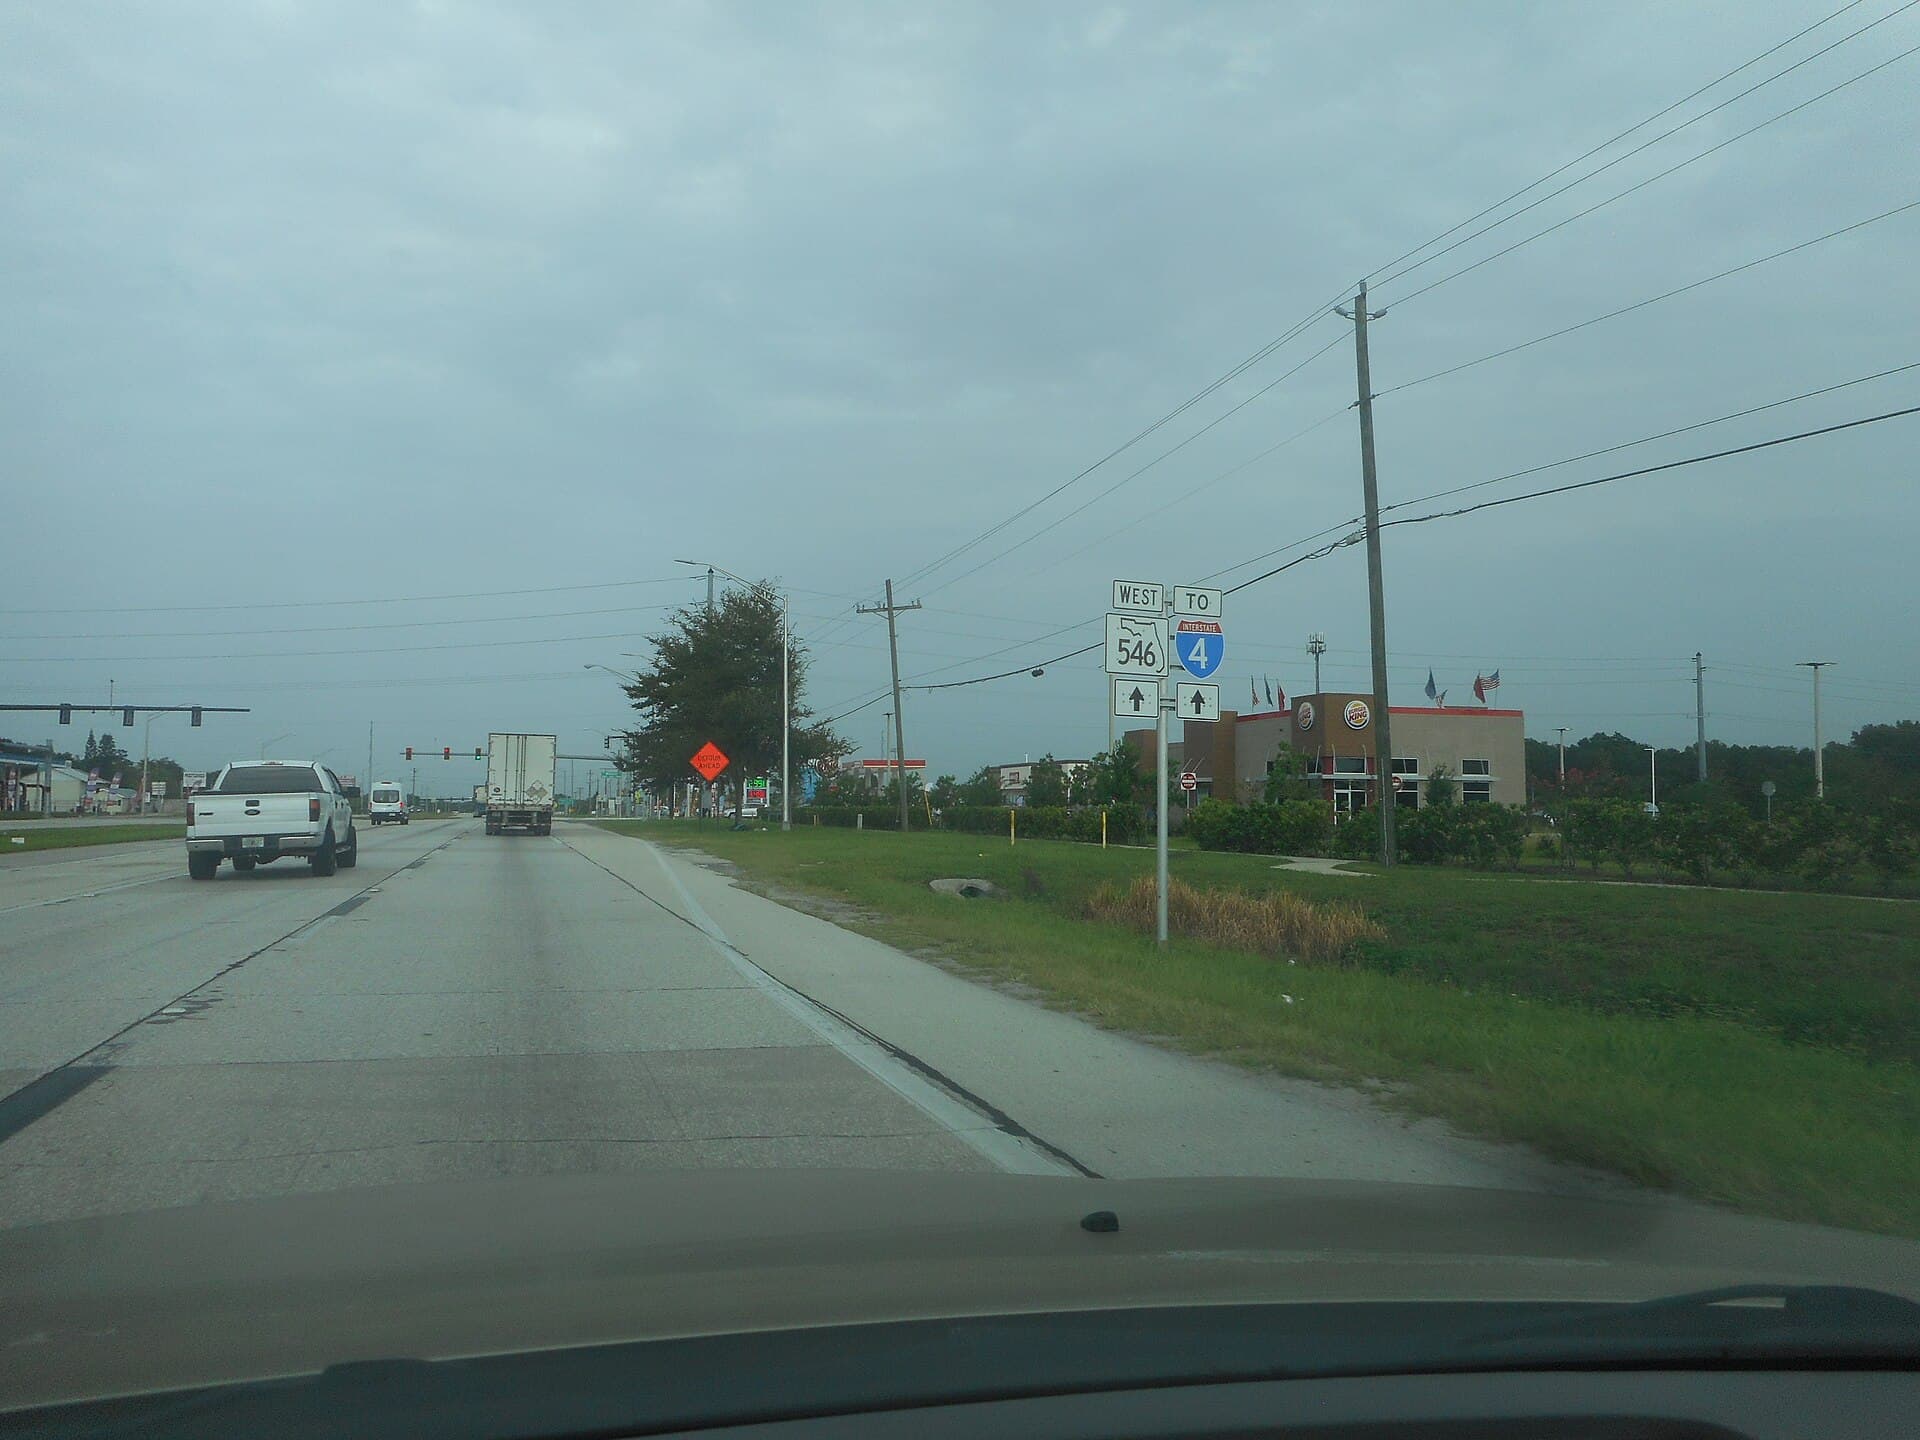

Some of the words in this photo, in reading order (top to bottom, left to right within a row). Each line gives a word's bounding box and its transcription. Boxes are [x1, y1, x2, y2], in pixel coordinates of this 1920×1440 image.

[1120, 585, 1157, 606] WEST
[1185, 592, 1209, 611] TO
[1182, 623, 1217, 632] INTERSTATE
[1118, 638, 1156, 667] 546
[1188, 637, 1208, 670] 4
[1349, 710, 1368, 722] KING
